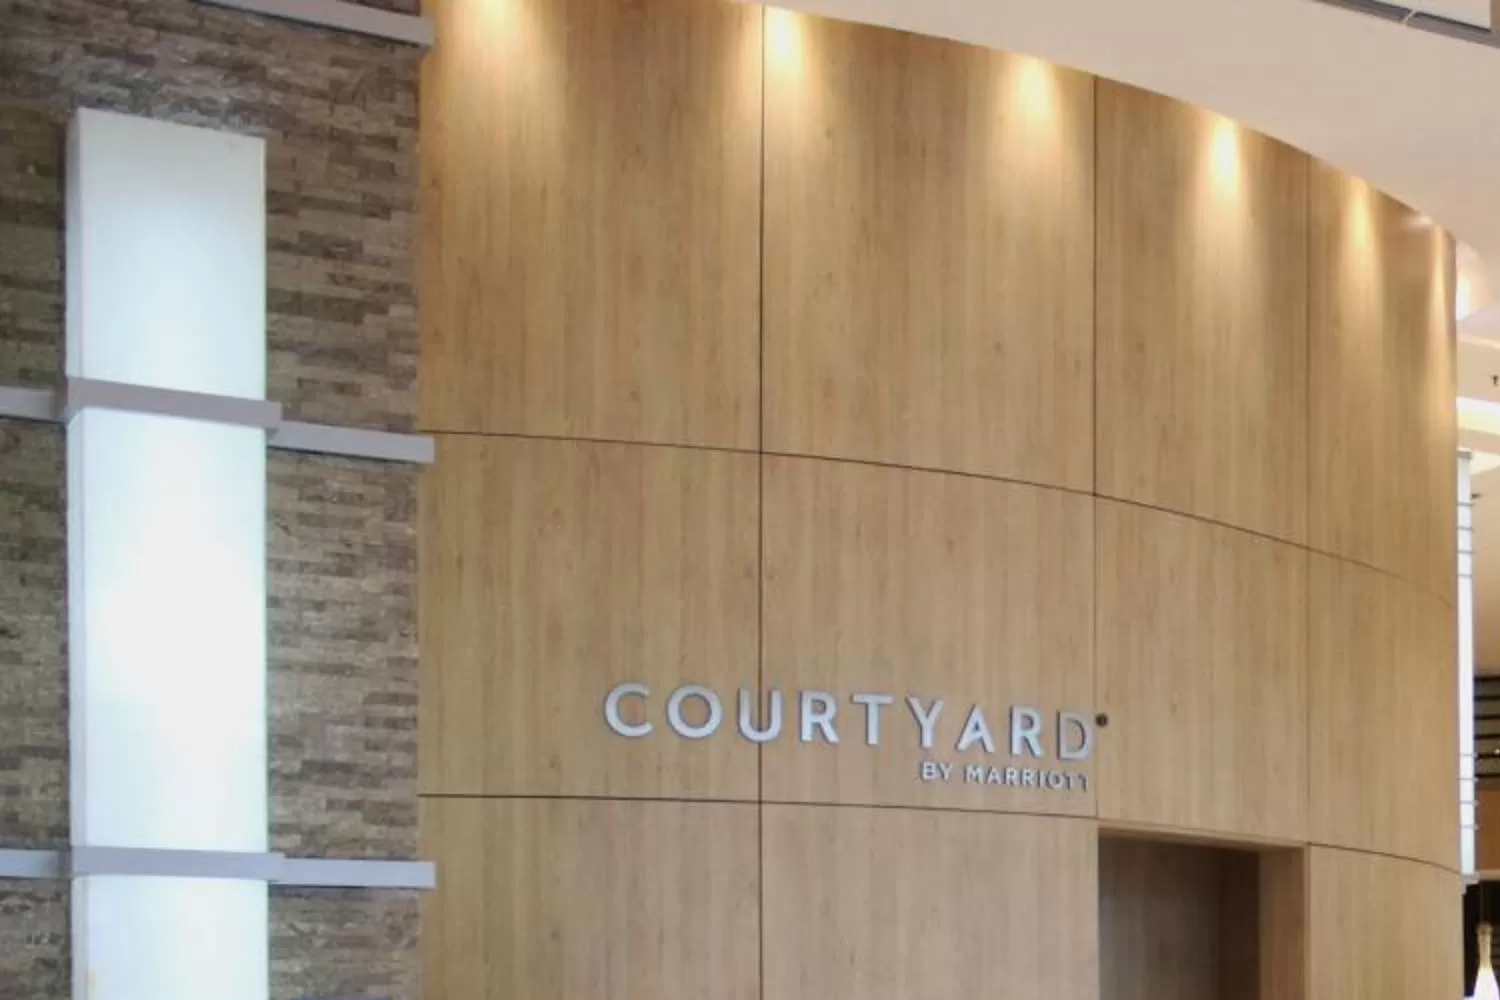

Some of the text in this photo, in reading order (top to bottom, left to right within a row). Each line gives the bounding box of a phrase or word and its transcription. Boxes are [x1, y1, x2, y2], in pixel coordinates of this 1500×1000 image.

[604, 682, 1094, 761] COURTYARD
[920, 760, 1089, 792] BY MARRIOTT
